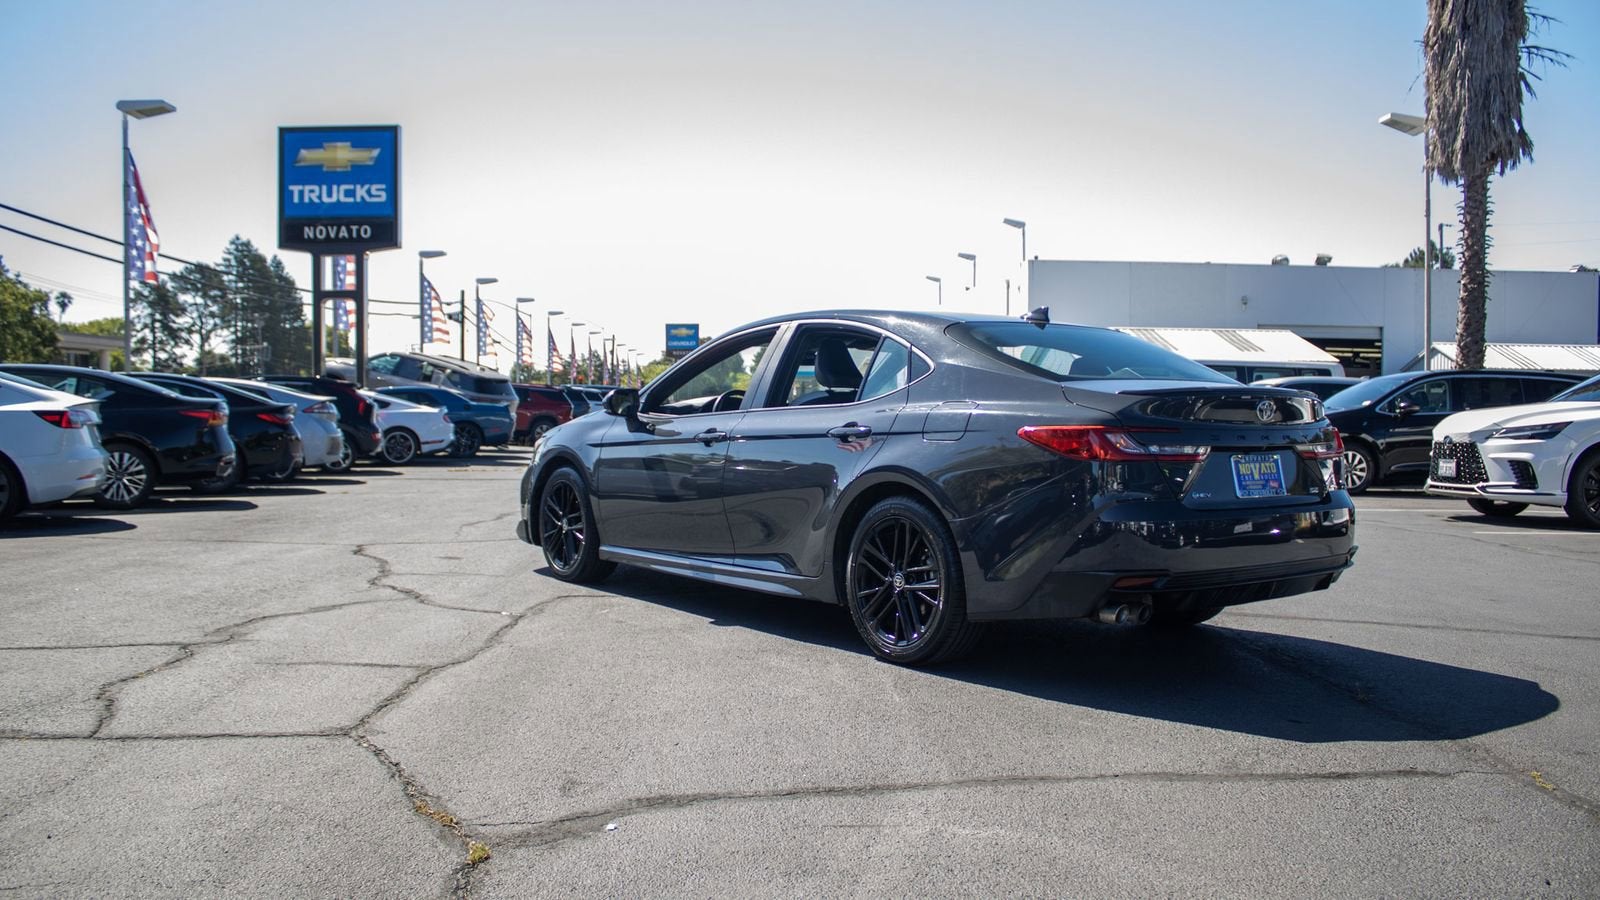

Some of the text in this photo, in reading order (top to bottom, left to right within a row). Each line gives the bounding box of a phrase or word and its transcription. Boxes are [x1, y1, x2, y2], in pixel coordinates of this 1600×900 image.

[289, 184, 387, 203] TRUCKS
[303, 225, 372, 239] NOVATO
[1238, 463, 1277, 480] NOVATO
